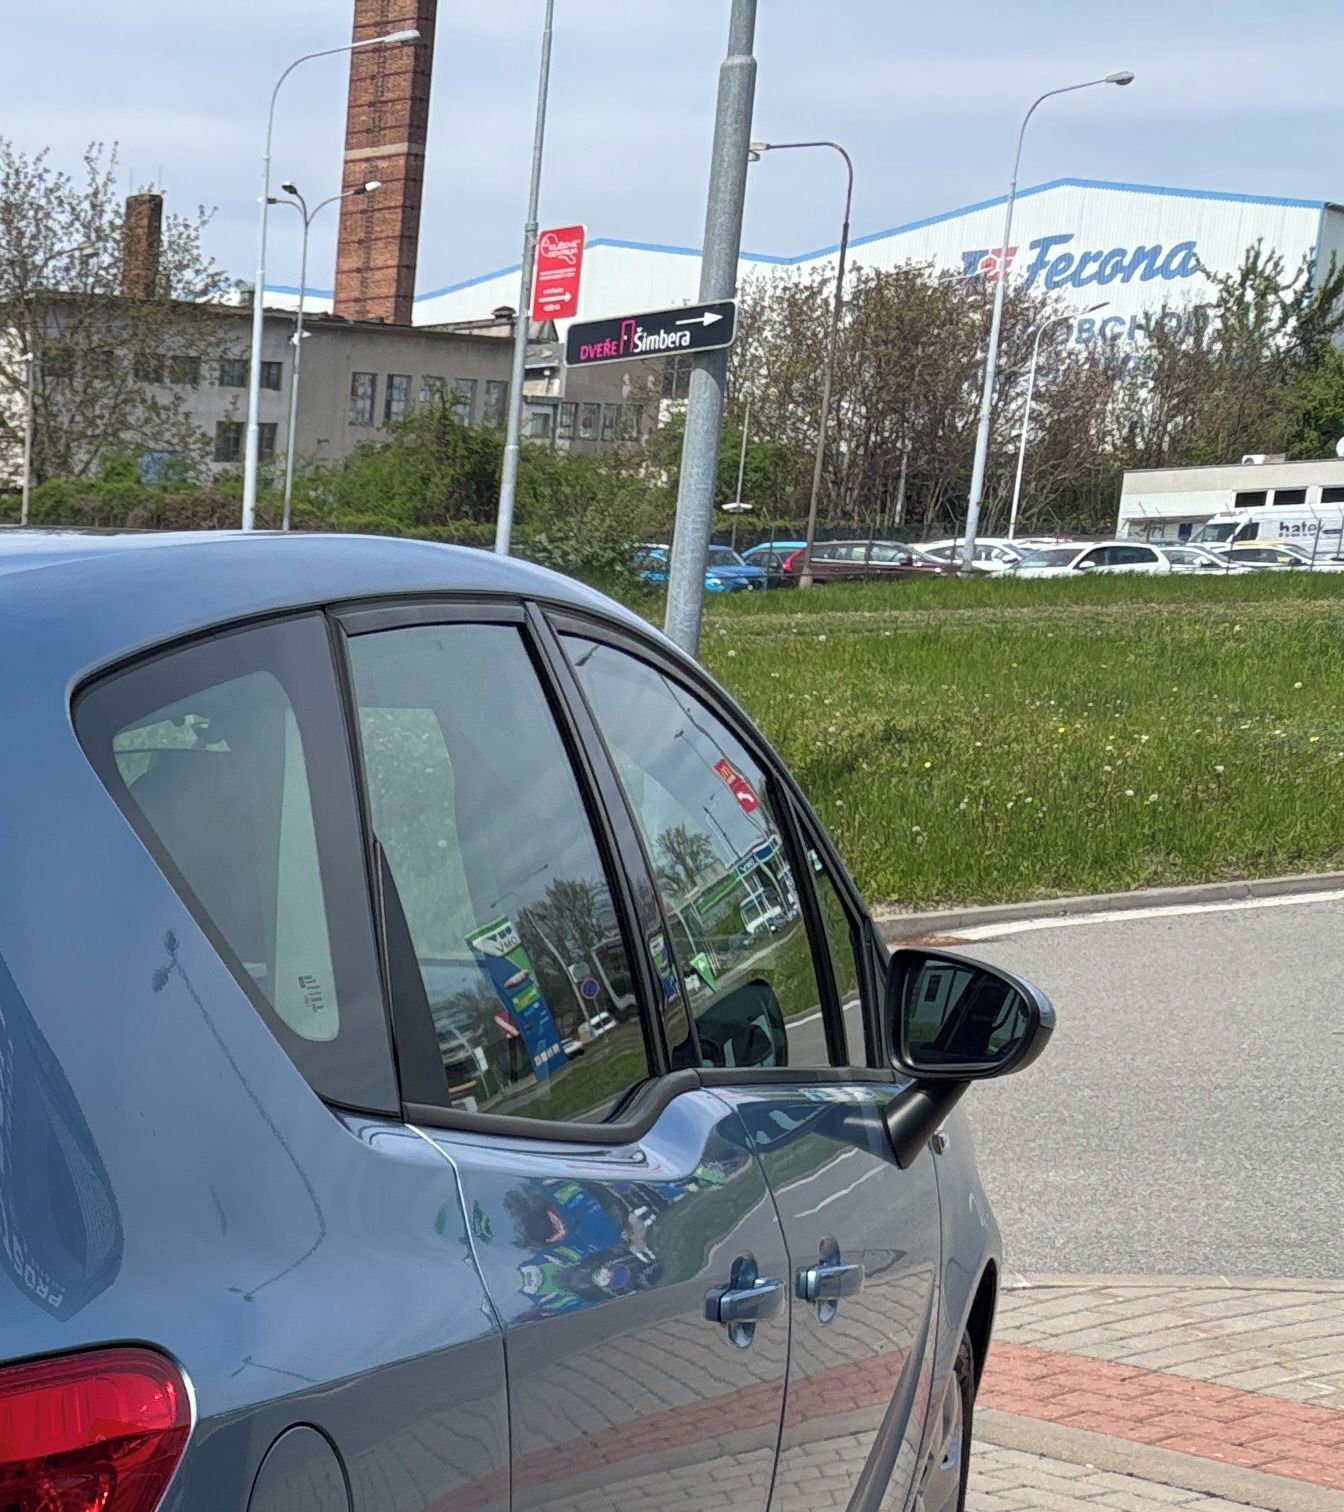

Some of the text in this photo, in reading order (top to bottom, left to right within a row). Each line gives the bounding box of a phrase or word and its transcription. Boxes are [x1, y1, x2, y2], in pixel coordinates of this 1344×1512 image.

[1023, 233, 1200, 292] Ferona
[579, 327, 691, 360] DVEŘE Šimbera
